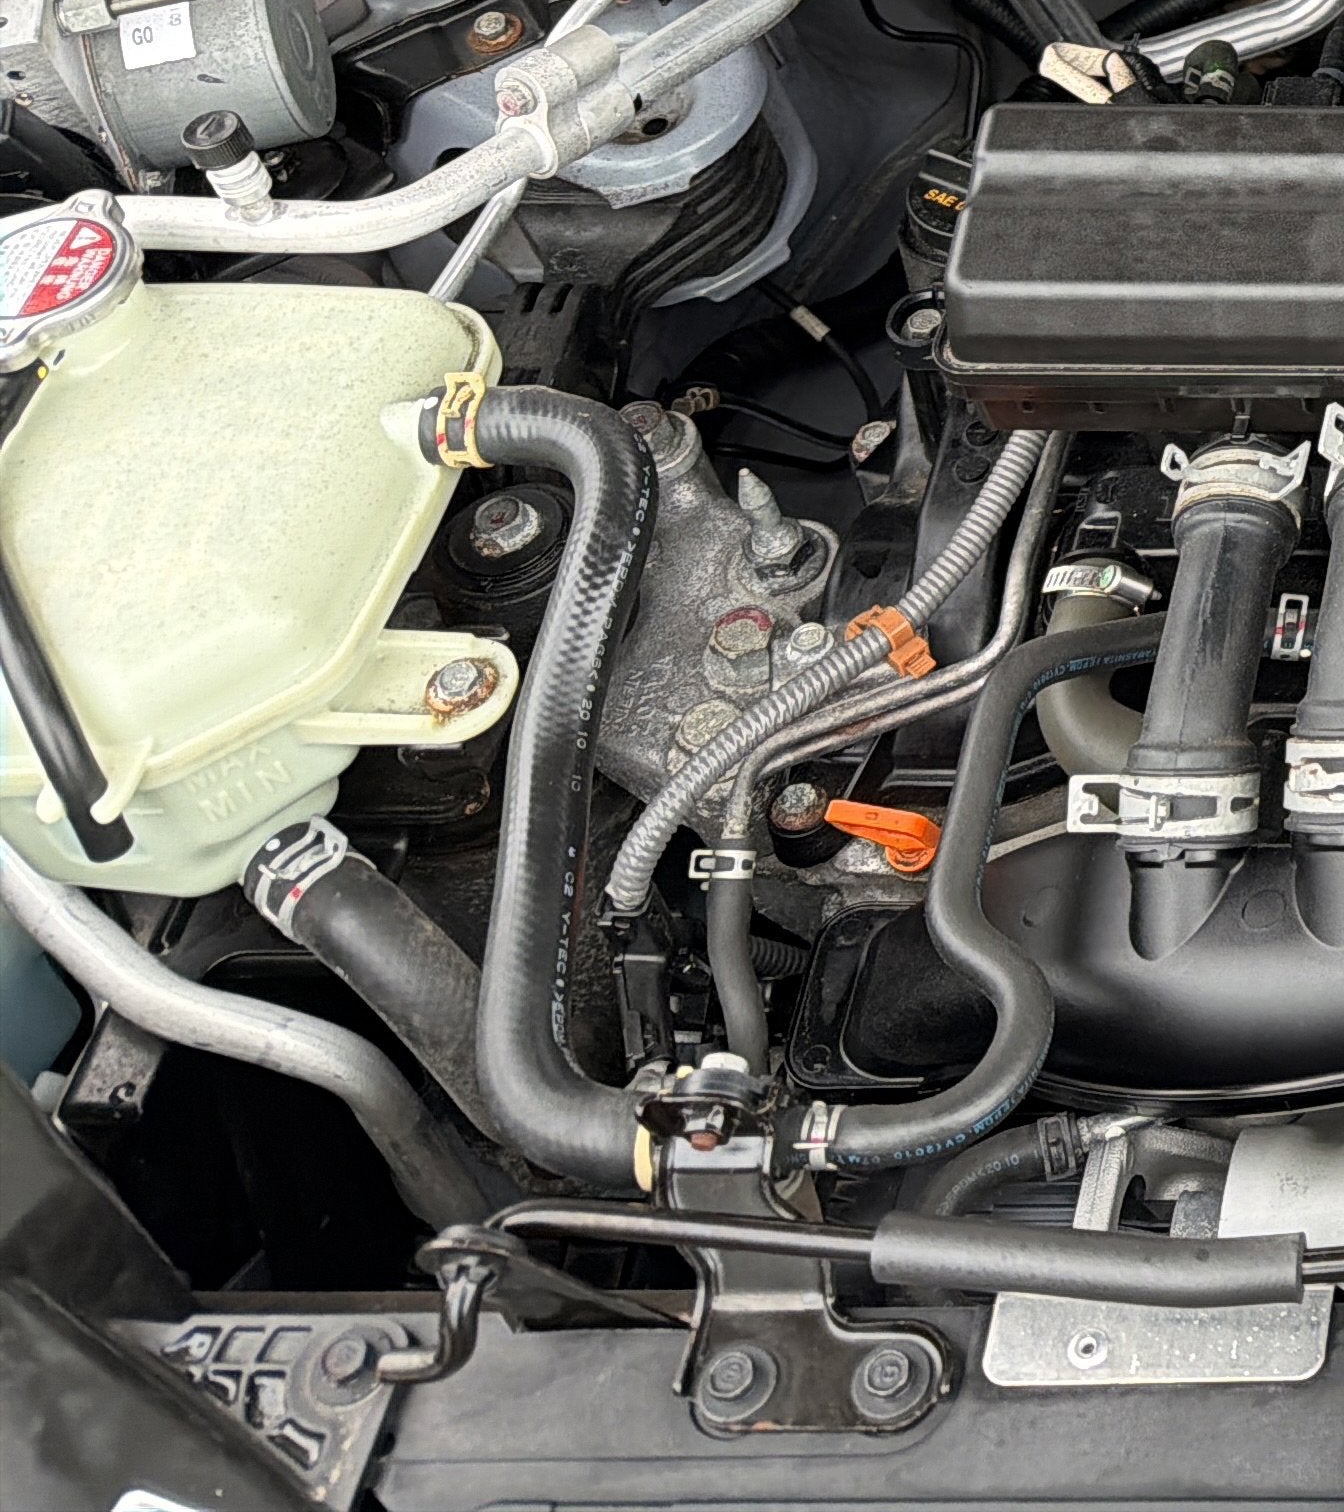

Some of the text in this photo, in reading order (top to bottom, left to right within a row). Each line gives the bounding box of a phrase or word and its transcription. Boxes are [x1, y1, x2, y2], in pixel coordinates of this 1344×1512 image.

[924, 189, 959, 207] SAE
[634, 461, 654, 525] Y-TEC
[579, 698, 593, 721] 20
[576, 730, 589, 750] 10
[201, 758, 294, 824] MIN
[563, 871, 575, 898] C2
[556, 911, 572, 976] Y-TEC
